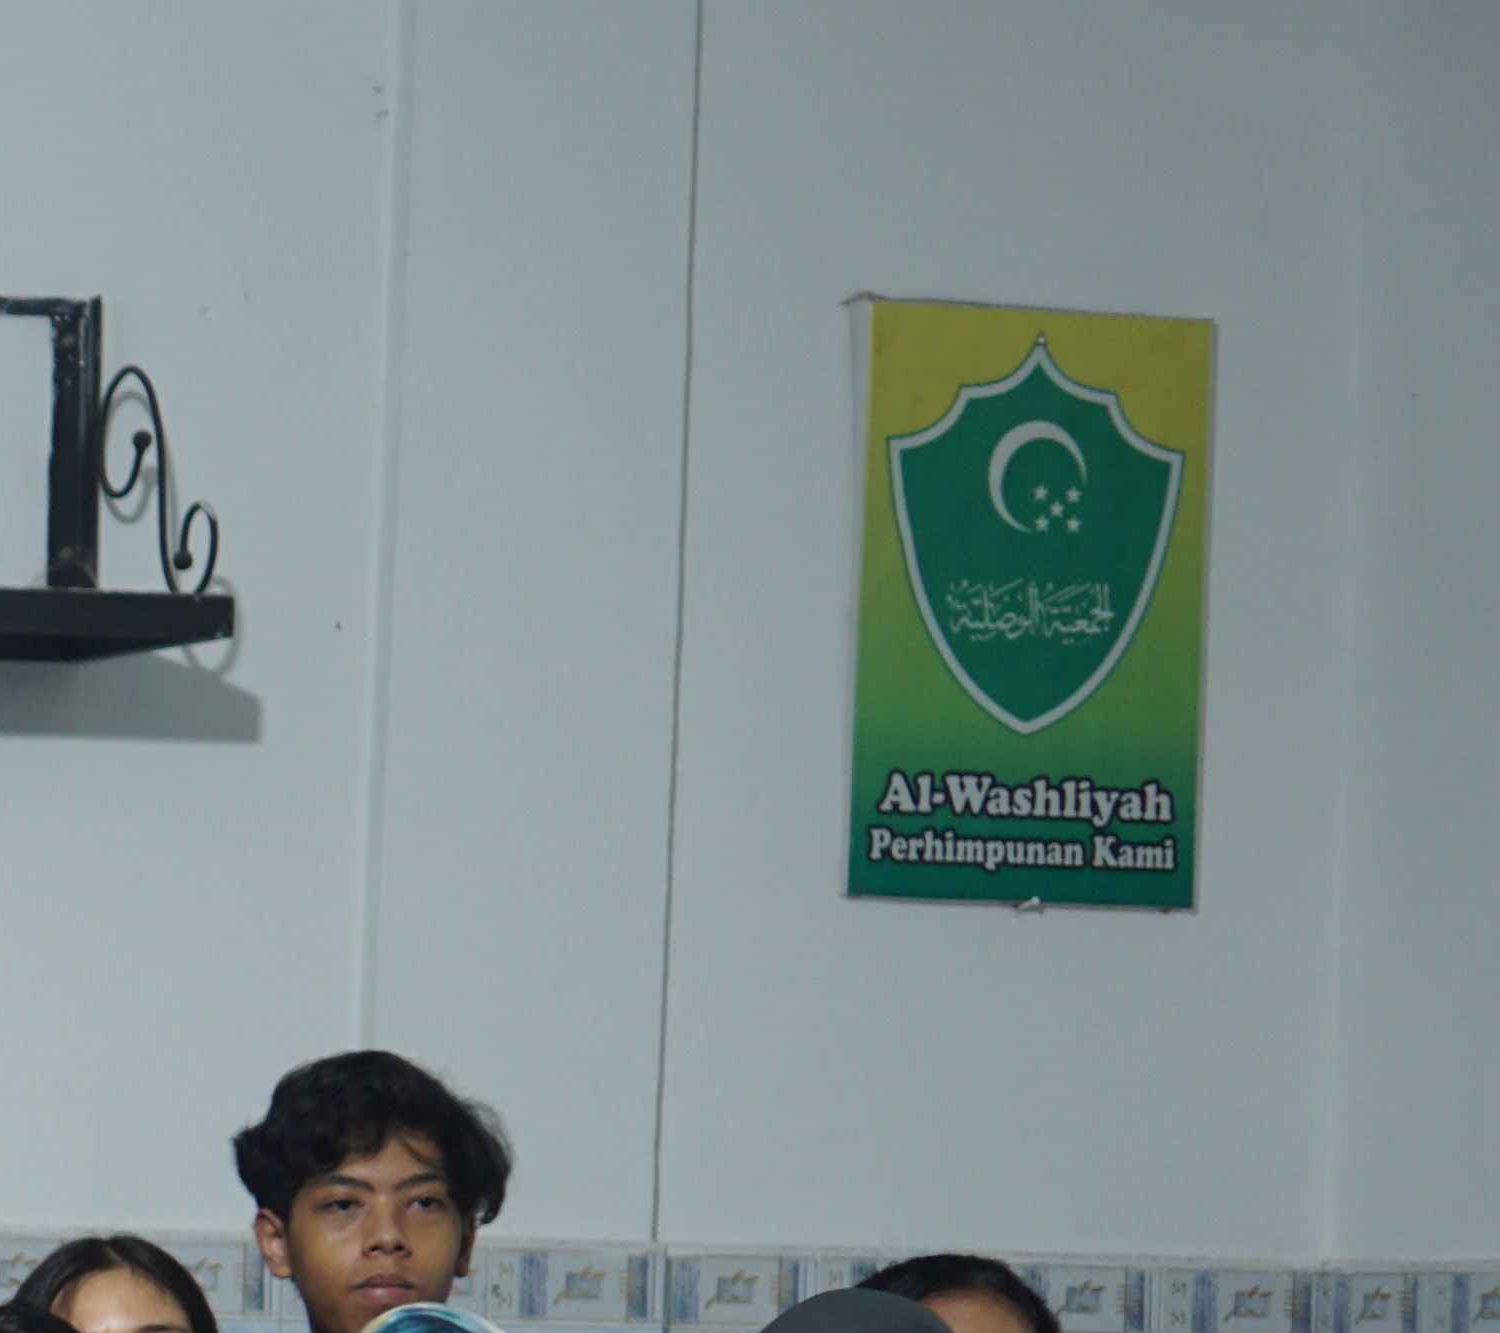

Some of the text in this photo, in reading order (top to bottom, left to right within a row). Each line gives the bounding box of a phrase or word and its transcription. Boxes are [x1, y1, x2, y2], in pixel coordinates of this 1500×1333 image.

[877, 770, 1173, 828] Al-Washliyah
[869, 827, 1175, 871] Perhimpunan Kami
